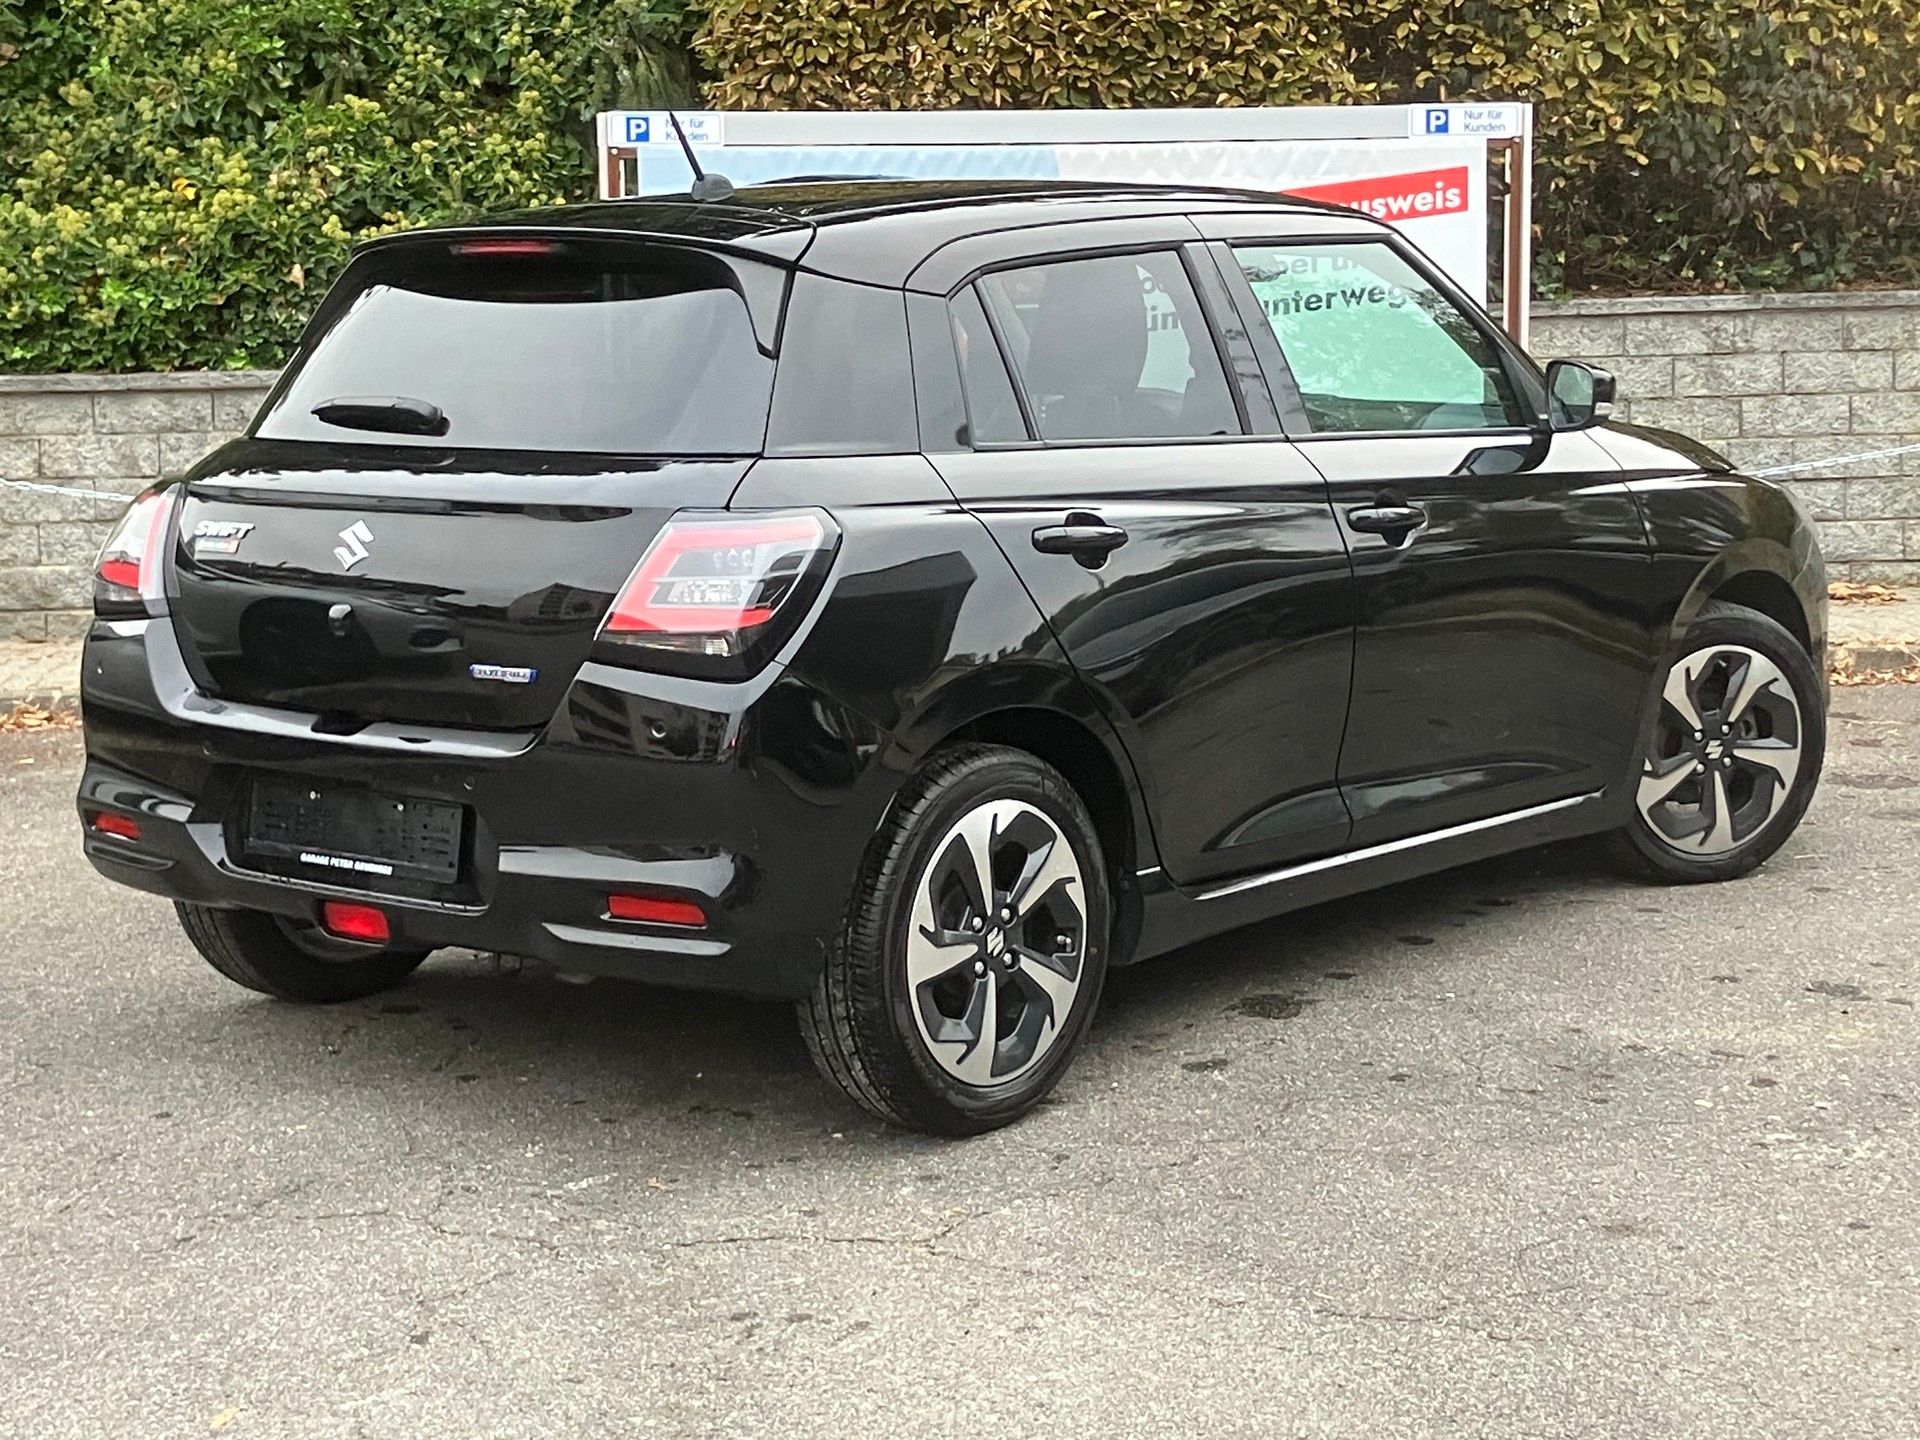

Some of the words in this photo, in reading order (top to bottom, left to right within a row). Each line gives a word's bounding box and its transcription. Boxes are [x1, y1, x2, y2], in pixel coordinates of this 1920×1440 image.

[1464, 110, 1483, 120] Nur
[1488, 109, 1503, 120] für
[665, 118, 685, 128] Nr
[689, 117, 704, 128] für
[1429, 110, 1446, 133] P
[1464, 122, 1506, 132] Kunden
[629, 119, 647, 141] P
[194, 520, 255, 538] SWIFT
[330, 857, 354, 869] PETER
